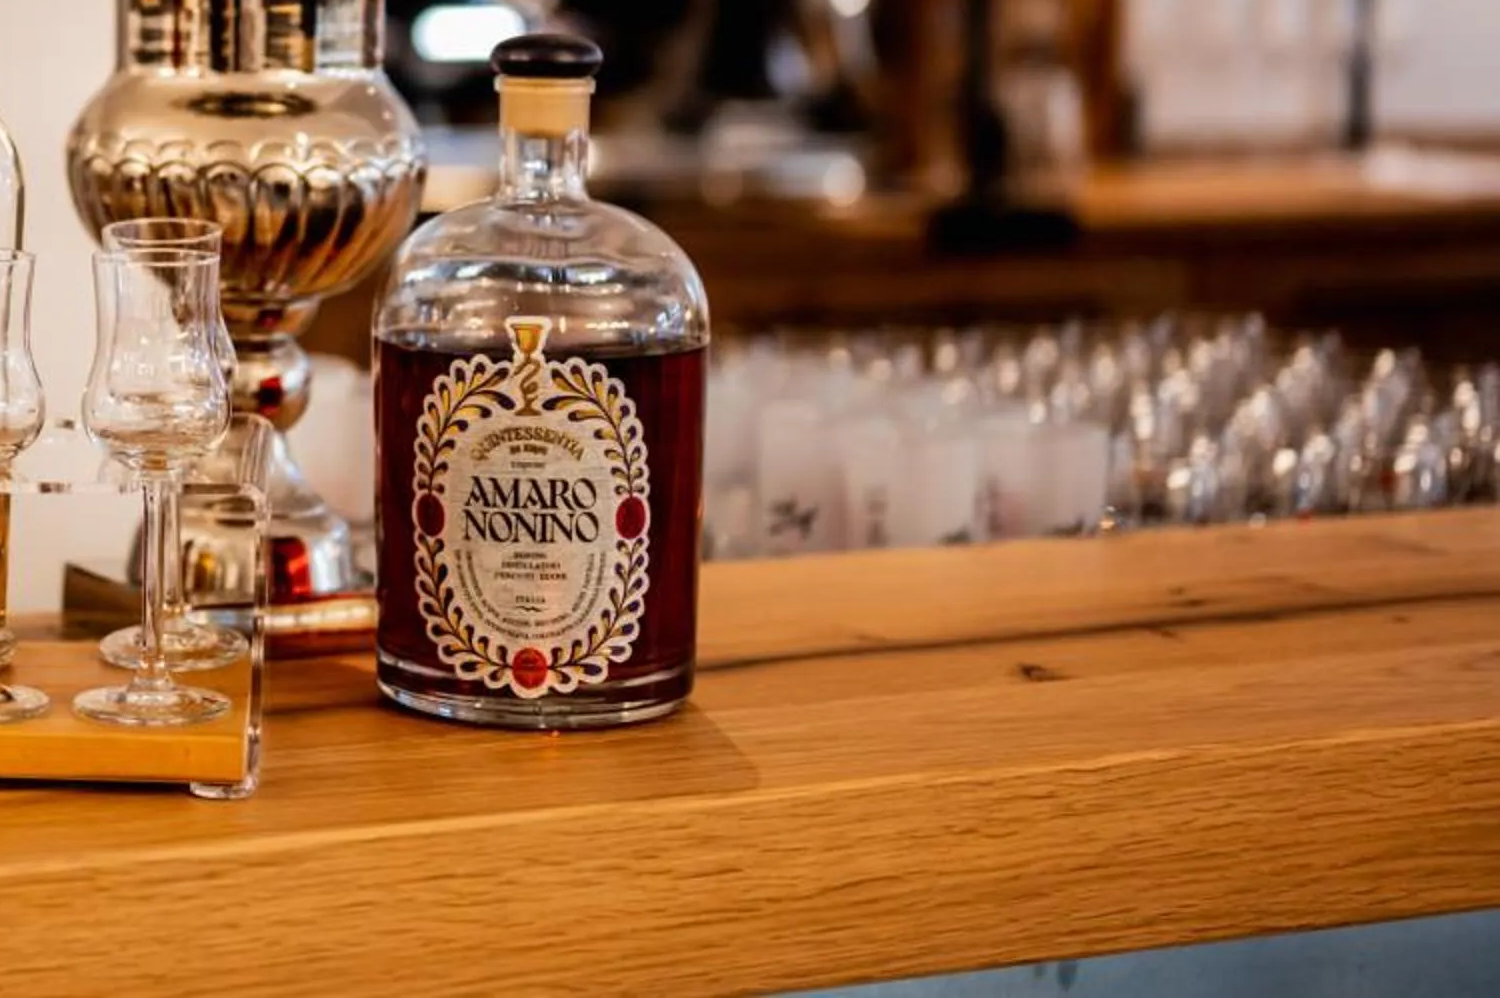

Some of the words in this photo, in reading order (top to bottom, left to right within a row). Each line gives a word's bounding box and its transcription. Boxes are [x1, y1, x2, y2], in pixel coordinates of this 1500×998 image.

[470, 426, 585, 461] QUINTESSENTIA
[464, 476, 597, 511] AMARO
[463, 509, 599, 543] NONINO
